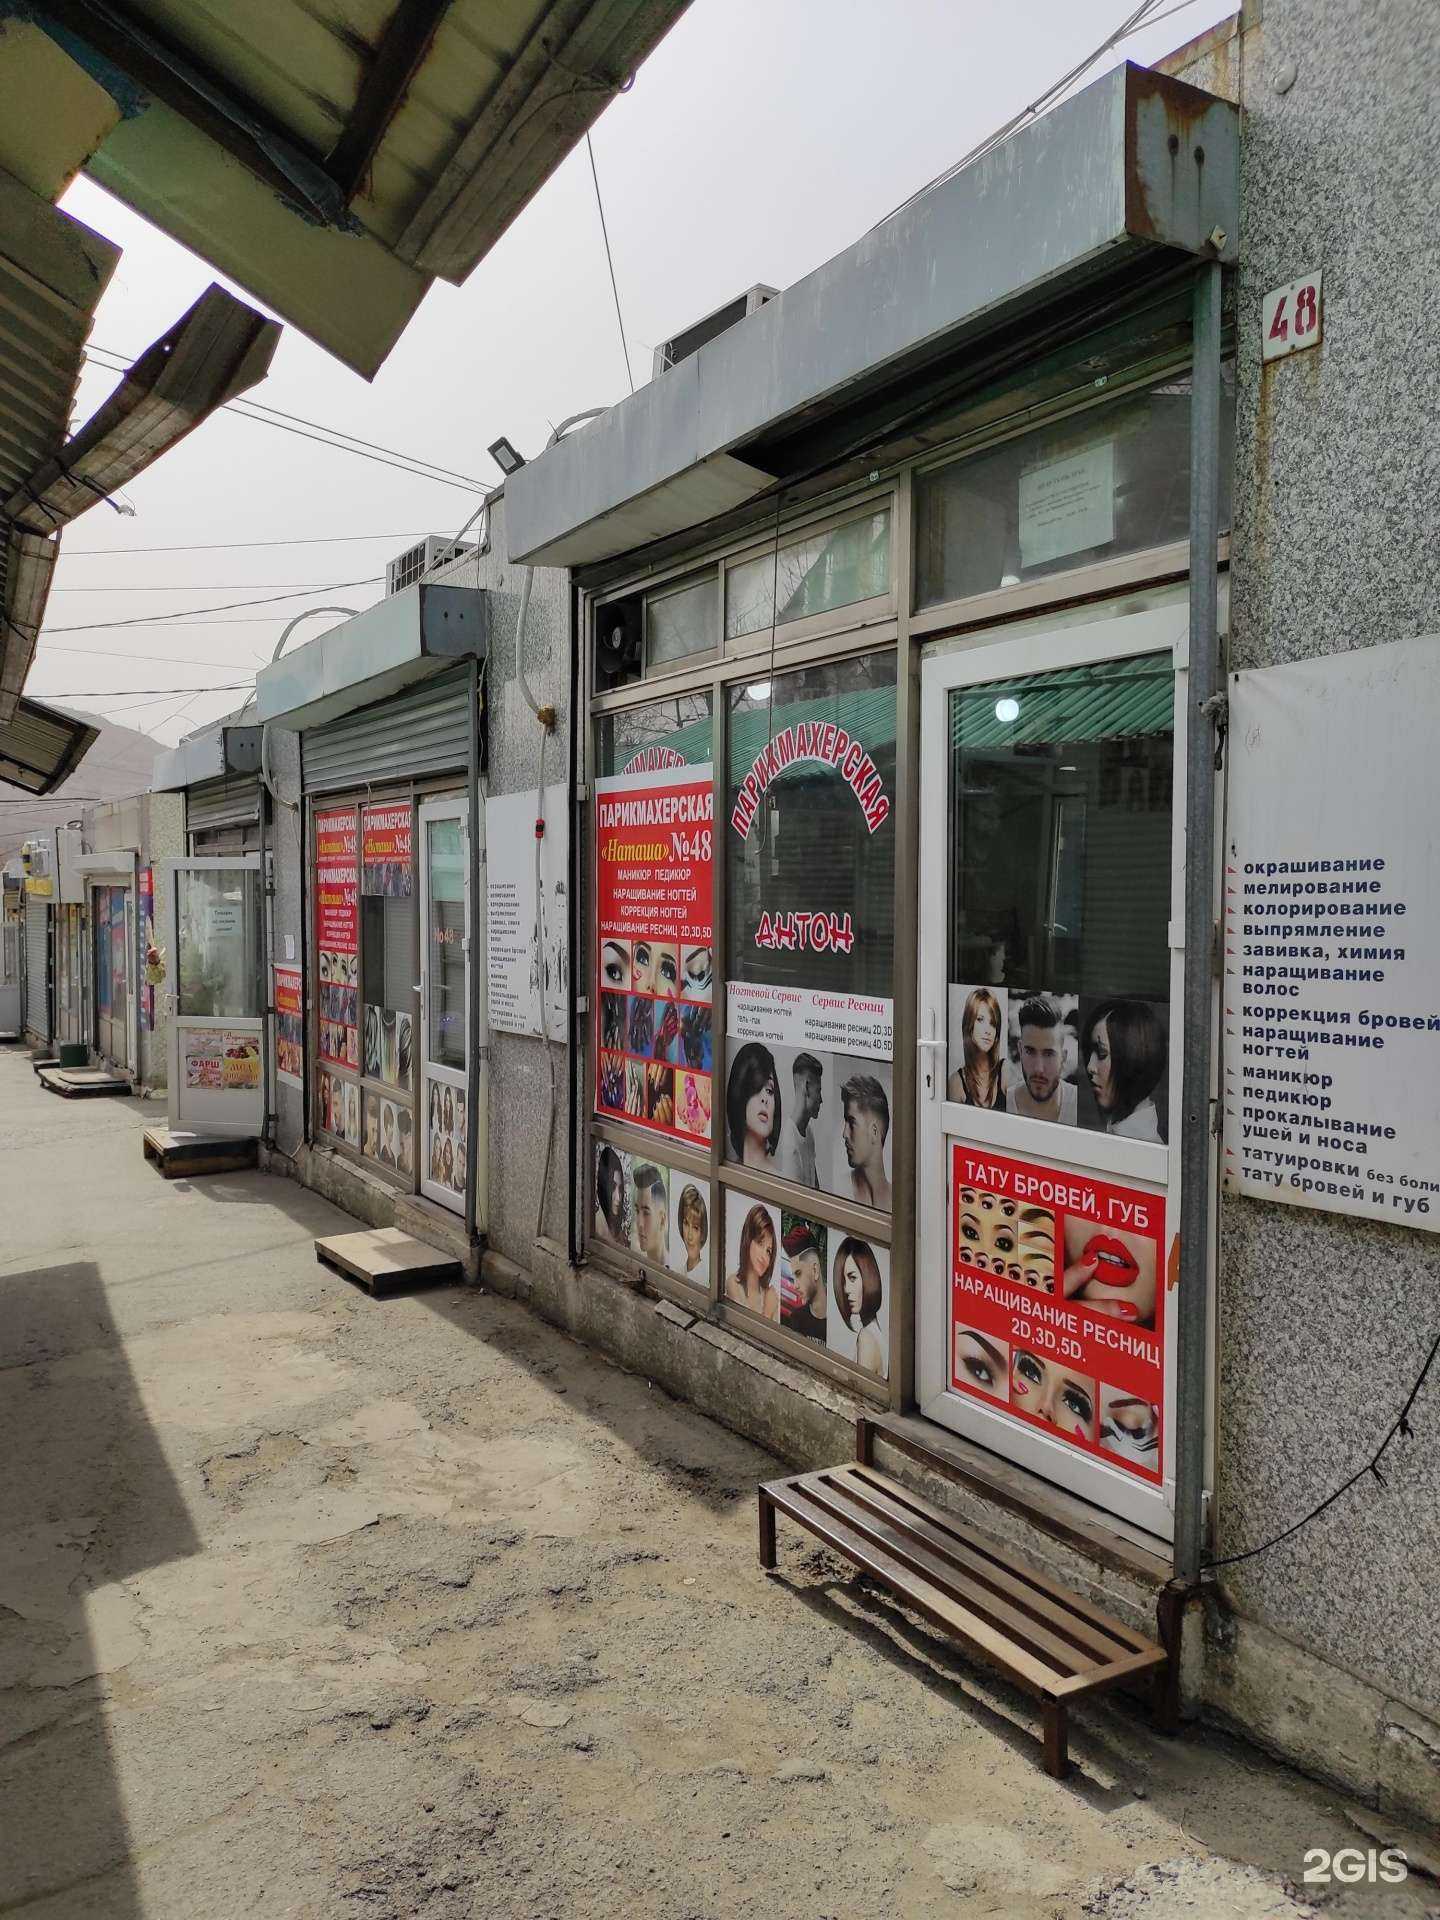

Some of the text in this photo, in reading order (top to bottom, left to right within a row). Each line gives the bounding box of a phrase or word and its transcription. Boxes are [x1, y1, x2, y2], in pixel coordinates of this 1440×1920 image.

[1268, 286, 1316, 342] 48
[731, 721, 890, 840] ПАРИКМАХЕРСКАЯ
[600, 793, 713, 827] ПАРИКМАХЕРСКАЯ
[669, 829, 712, 863] №48
[617, 869, 691, 883] МАНИКЮР ПЕДИКЮР
[1243, 857, 1385, 875] окрашивание
[613, 887, 697, 901] НАРАЩИВАНИЕ НОГТЕЙ
[1243, 880, 1381, 895] мелирование
[620, 906, 688, 918] КОРРЕКЦИЯ НОГТЕЙ
[1243, 901, 1406, 917] колорирование
[650, 923, 678, 938] РЕСНИЦ
[755, 911, 854, 954] АНТОН
[1243, 923, 1386, 940] выпрямление
[1243, 944, 1405, 961] завивка, химия
[1243, 965, 1385, 982] наращивание
[729, 984, 770, 999] Ногтевой
[1243, 983, 1299, 997] волос
[812, 994, 884, 1016] Сервис Ресниц
[1243, 1005, 1440, 1030] коррекция бровей
[847, 1024, 872, 1034] ресниц
[1243, 1026, 1385, 1049] наращивание
[847, 1038, 872, 1048] ресниц
[1243, 1043, 1309, 1061] ногтей
[1243, 1066, 1333, 1088] маникюр
[1243, 1086, 1332, 1110] педикюр
[1243, 1106, 1396, 1140] прокалывание
[1242, 1124, 1367, 1154] ушей и носа
[1242, 1146, 1440, 1192] татуировки без боли
[965, 1160, 1149, 1228] ТАТУ БРОВЕЙ, ГУБ
[1242, 1166, 1430, 1213] тату бровей и губ
[954, 1272, 1160, 1370] НАРАЩИВАНИЕ РЕСНИЦ
[1011, 1318, 1086, 1362] 2D,3D,5D.
